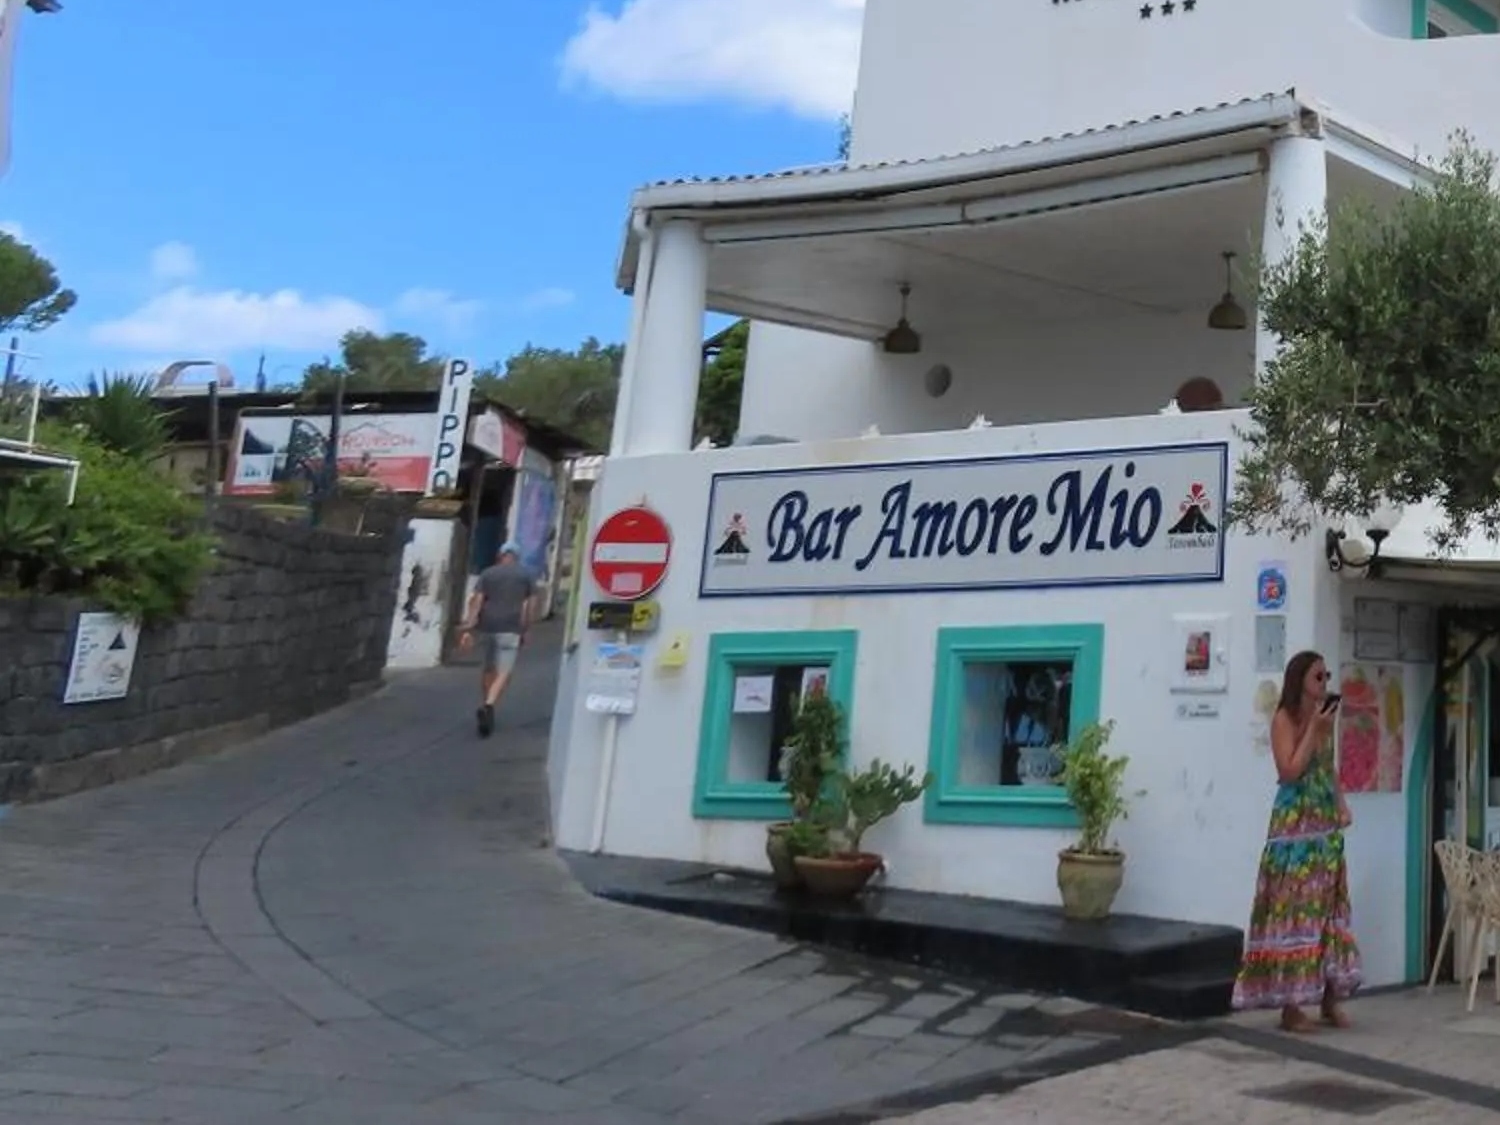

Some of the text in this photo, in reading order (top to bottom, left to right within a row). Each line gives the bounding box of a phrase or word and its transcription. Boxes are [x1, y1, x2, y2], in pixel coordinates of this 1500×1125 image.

[767, 461, 1163, 571] Bar Amore Mio
